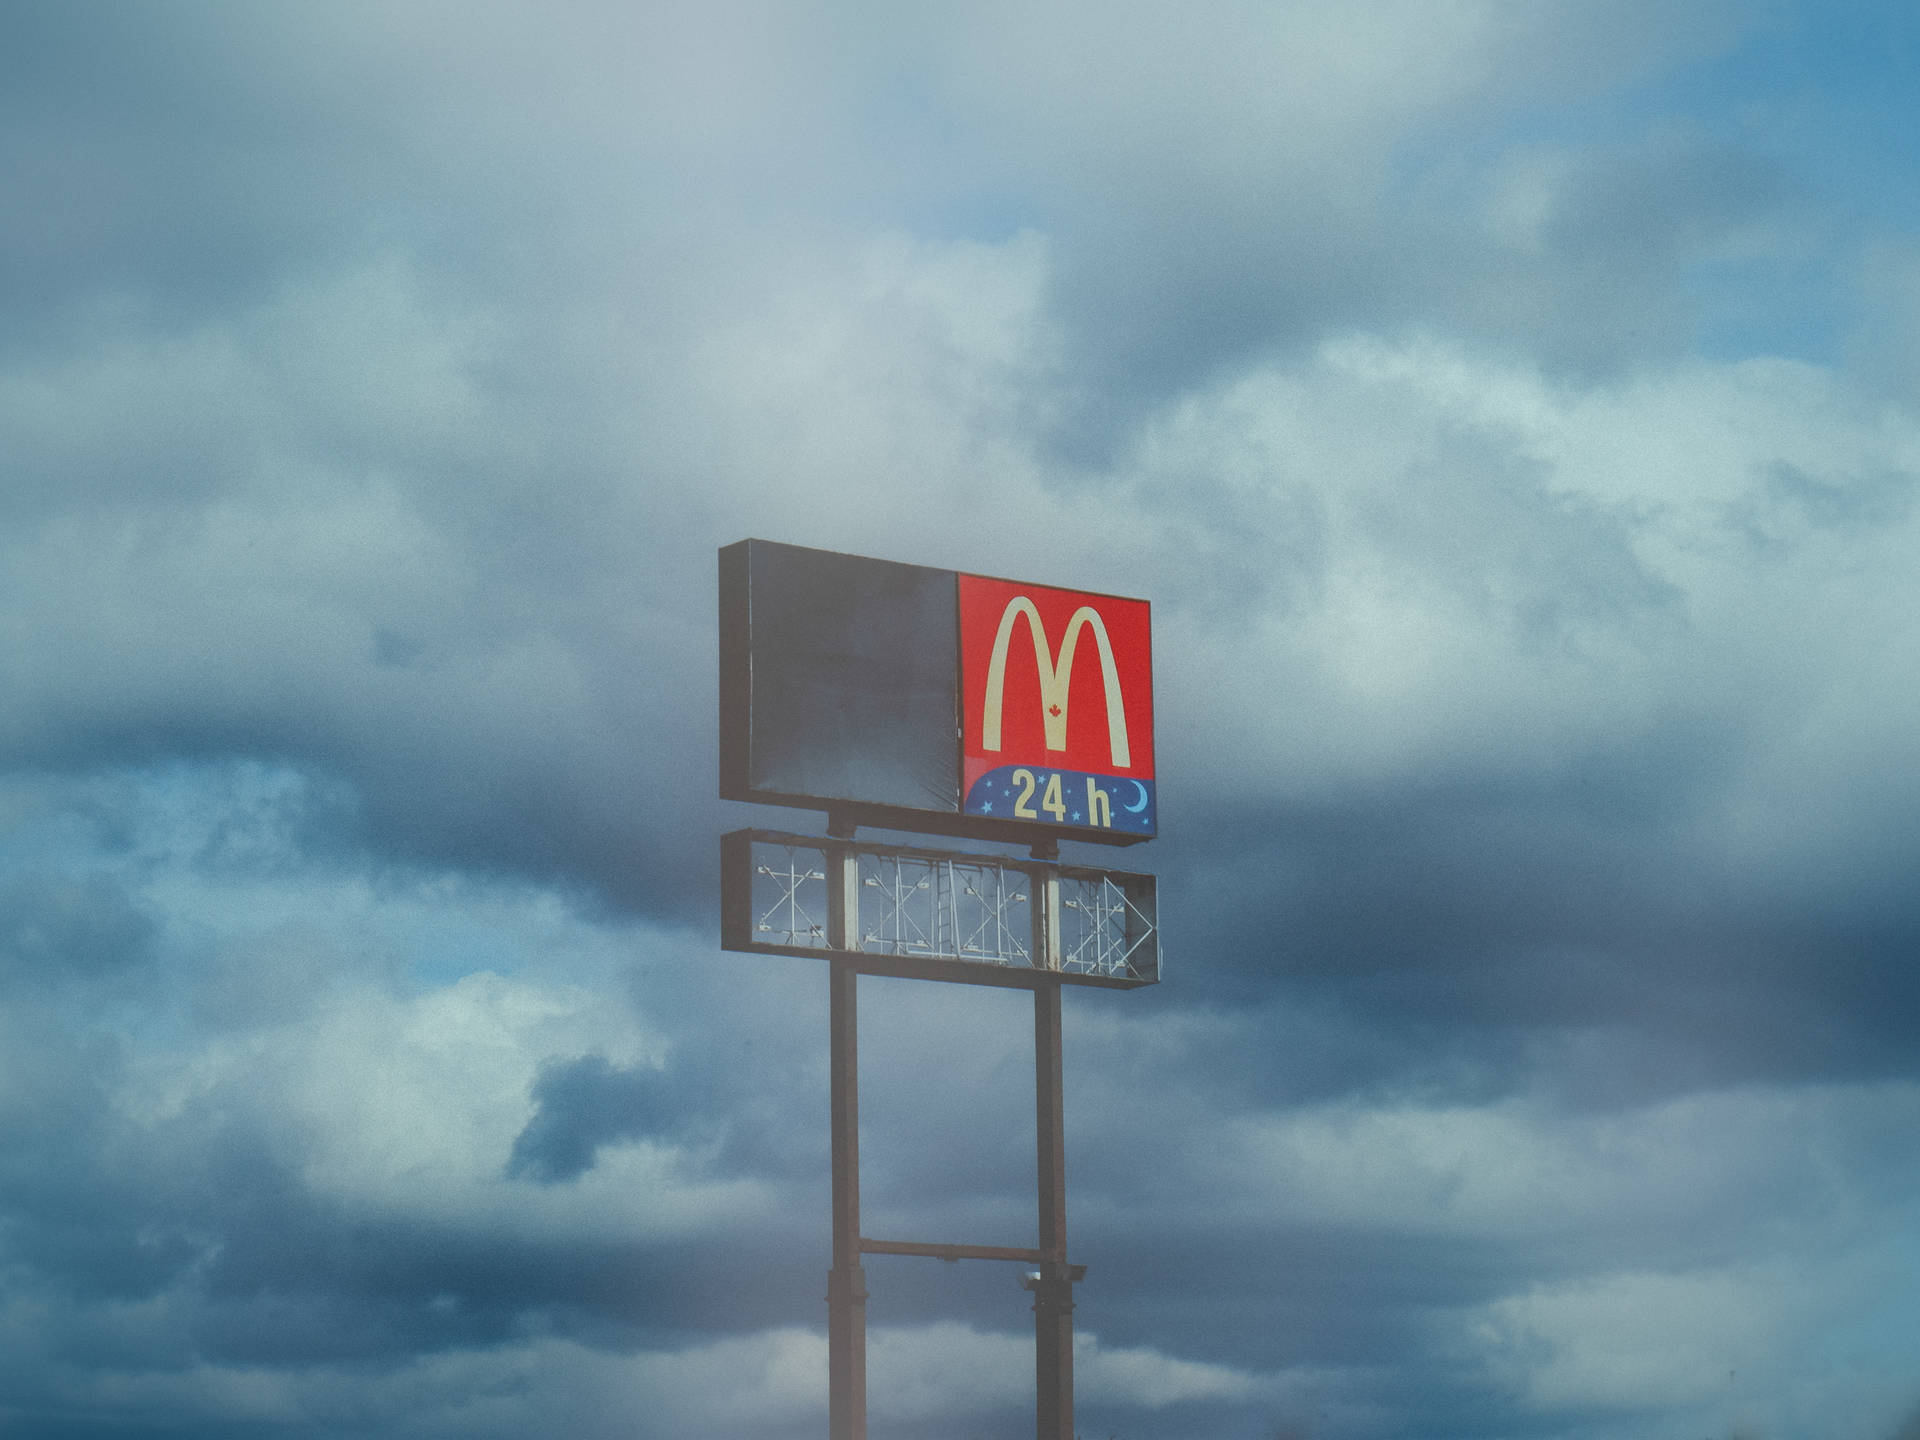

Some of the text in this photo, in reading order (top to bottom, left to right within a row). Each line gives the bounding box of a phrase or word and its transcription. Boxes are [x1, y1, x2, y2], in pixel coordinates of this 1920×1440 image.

[982, 595, 1131, 768] M
[1012, 768, 1111, 828] 24 h
